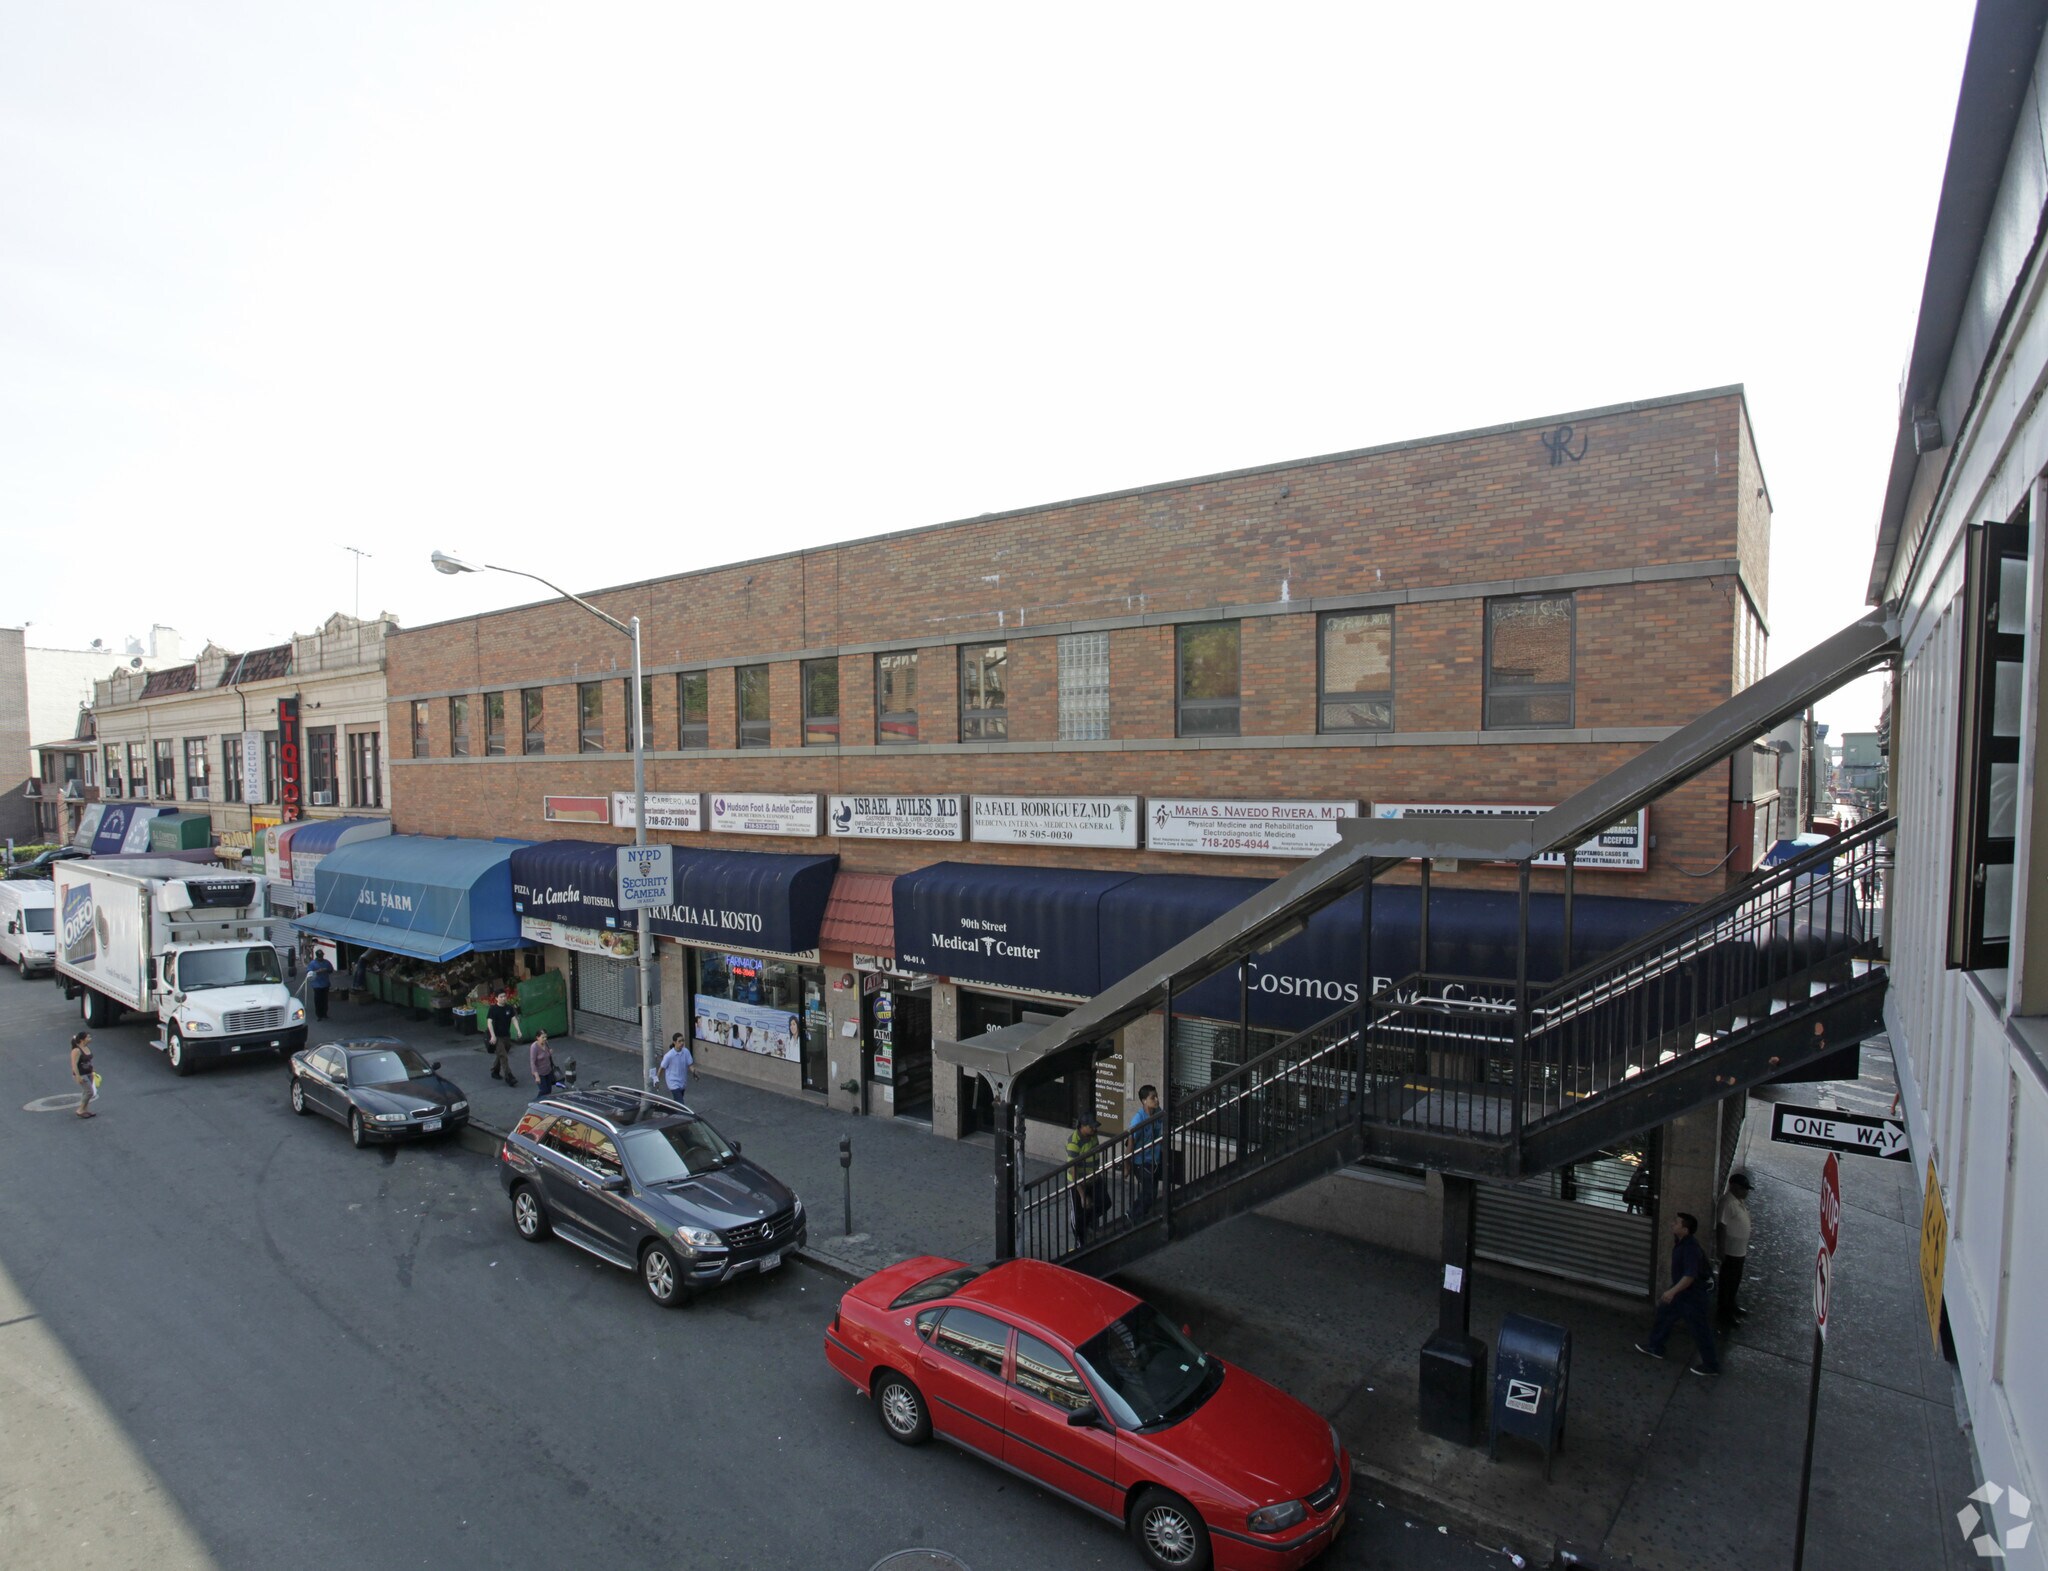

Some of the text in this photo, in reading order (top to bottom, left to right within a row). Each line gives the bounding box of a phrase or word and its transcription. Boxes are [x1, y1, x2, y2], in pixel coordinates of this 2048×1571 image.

[247, 740, 258, 795] ACUPUNTURA
[280, 701, 299, 823] LIQUOR
[727, 803, 749, 811] Hudson
[750, 803, 763, 811] Foot
[772, 804, 789, 812] Ankle
[791, 804, 813, 813] Center
[854, 798, 958, 817] ISRAEL AVILES M.D.
[975, 801, 1110, 819] RAFAEL RODRIGUEZ,MD
[1211, 806, 1222, 817] S.
[1224, 806, 1269, 818] NAVEDO
[648, 816, 689, 827] 718-672-1100
[975, 819, 1007, 827] MEDICINA
[1008, 820, 1038, 828] INTERNA
[1188, 821, 1313, 831] Physical Medicine and Rehabilitation
[857, 826, 955, 837] Tel:(718)396-2005
[1012, 830, 1073, 840] 718 505-0030
[1203, 829, 1296, 839] Electrodiagnostic Medicine
[1603, 826, 1638, 835] URANCES
[1201, 838, 1269, 849] 718-205-4944
[1603, 836, 1634, 846] ACCEPTED
[628, 850, 661, 862] NYPD
[622, 877, 668, 888] SECURITY
[359, 889, 412, 911] JSL FARM
[514, 884, 615, 908] PIZZA La Cancha ROTISERIA
[625, 888, 666, 900] CAMERA
[65, 900, 93, 948] OREO
[648, 904, 762, 933] RMACIA AL KOSTO
[961, 918, 1007, 932] 90th Street
[932, 933, 1041, 959] Medical Center
[726, 955, 763, 970] FARMACIA
[903, 954, 925, 965] 90-01 A
[1238, 963, 1359, 1003] Cosmos
[874, 1030, 890, 1040] ATM
[1793, 1118, 1903, 1148] ONE WAY
[1821, 1176, 1839, 1236] STOP
